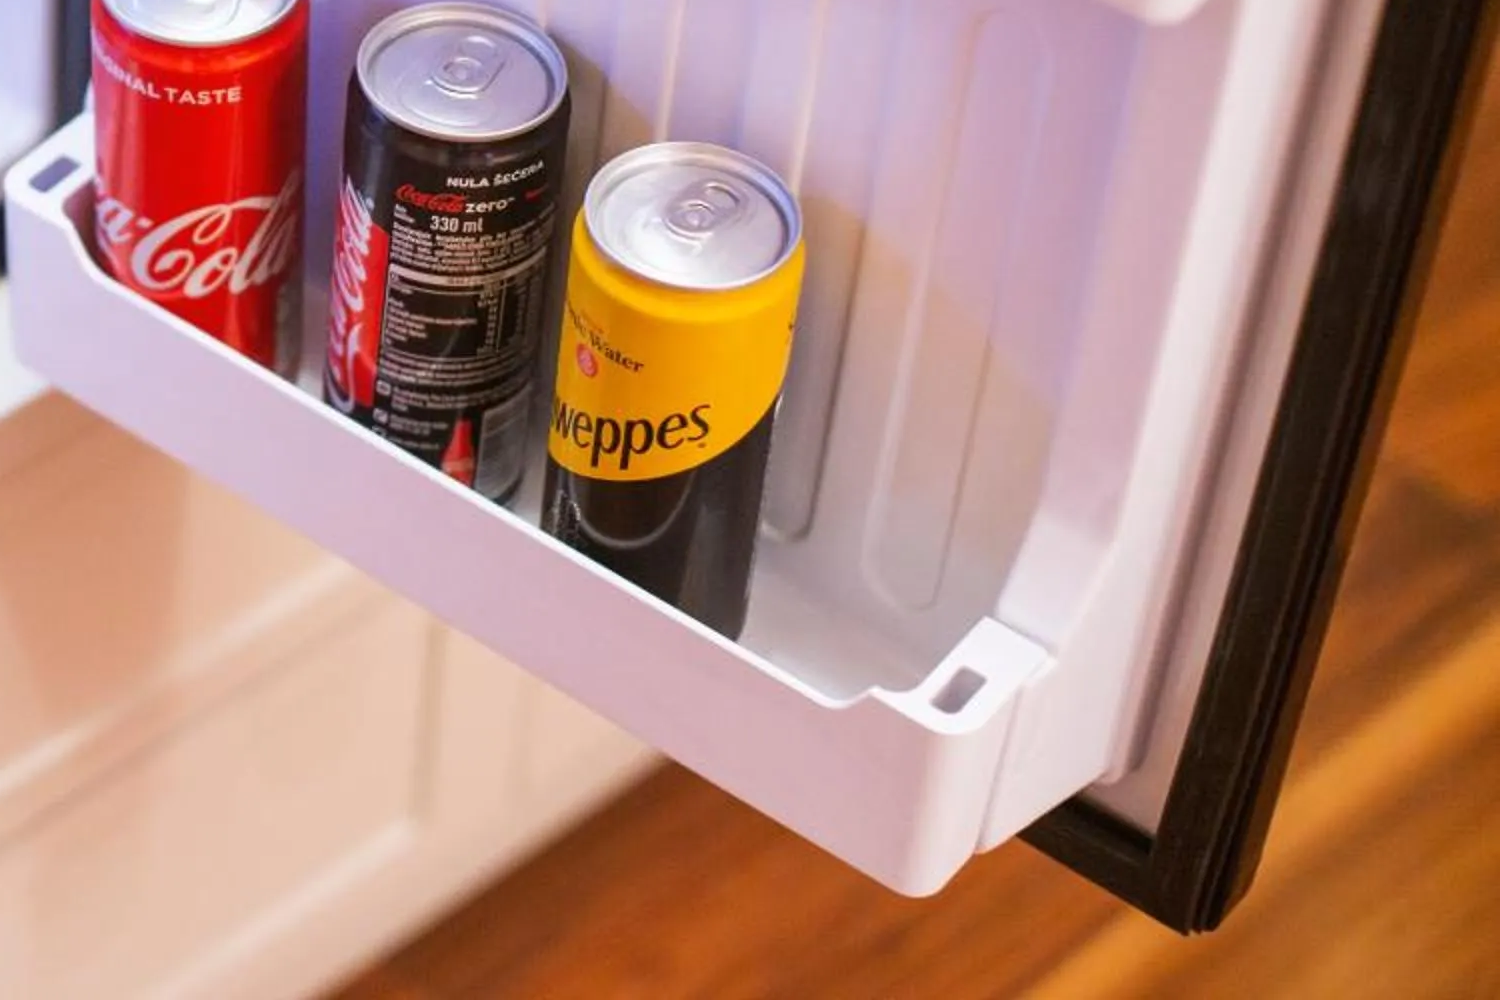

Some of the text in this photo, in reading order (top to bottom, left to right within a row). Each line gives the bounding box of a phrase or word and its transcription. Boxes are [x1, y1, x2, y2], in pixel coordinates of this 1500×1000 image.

[163, 86, 242, 105] TASTE
[446, 176, 490, 188] NULA
[465, 198, 509, 214] zero
[430, 215, 483, 234] 330 ml
[588, 329, 645, 373] Water
